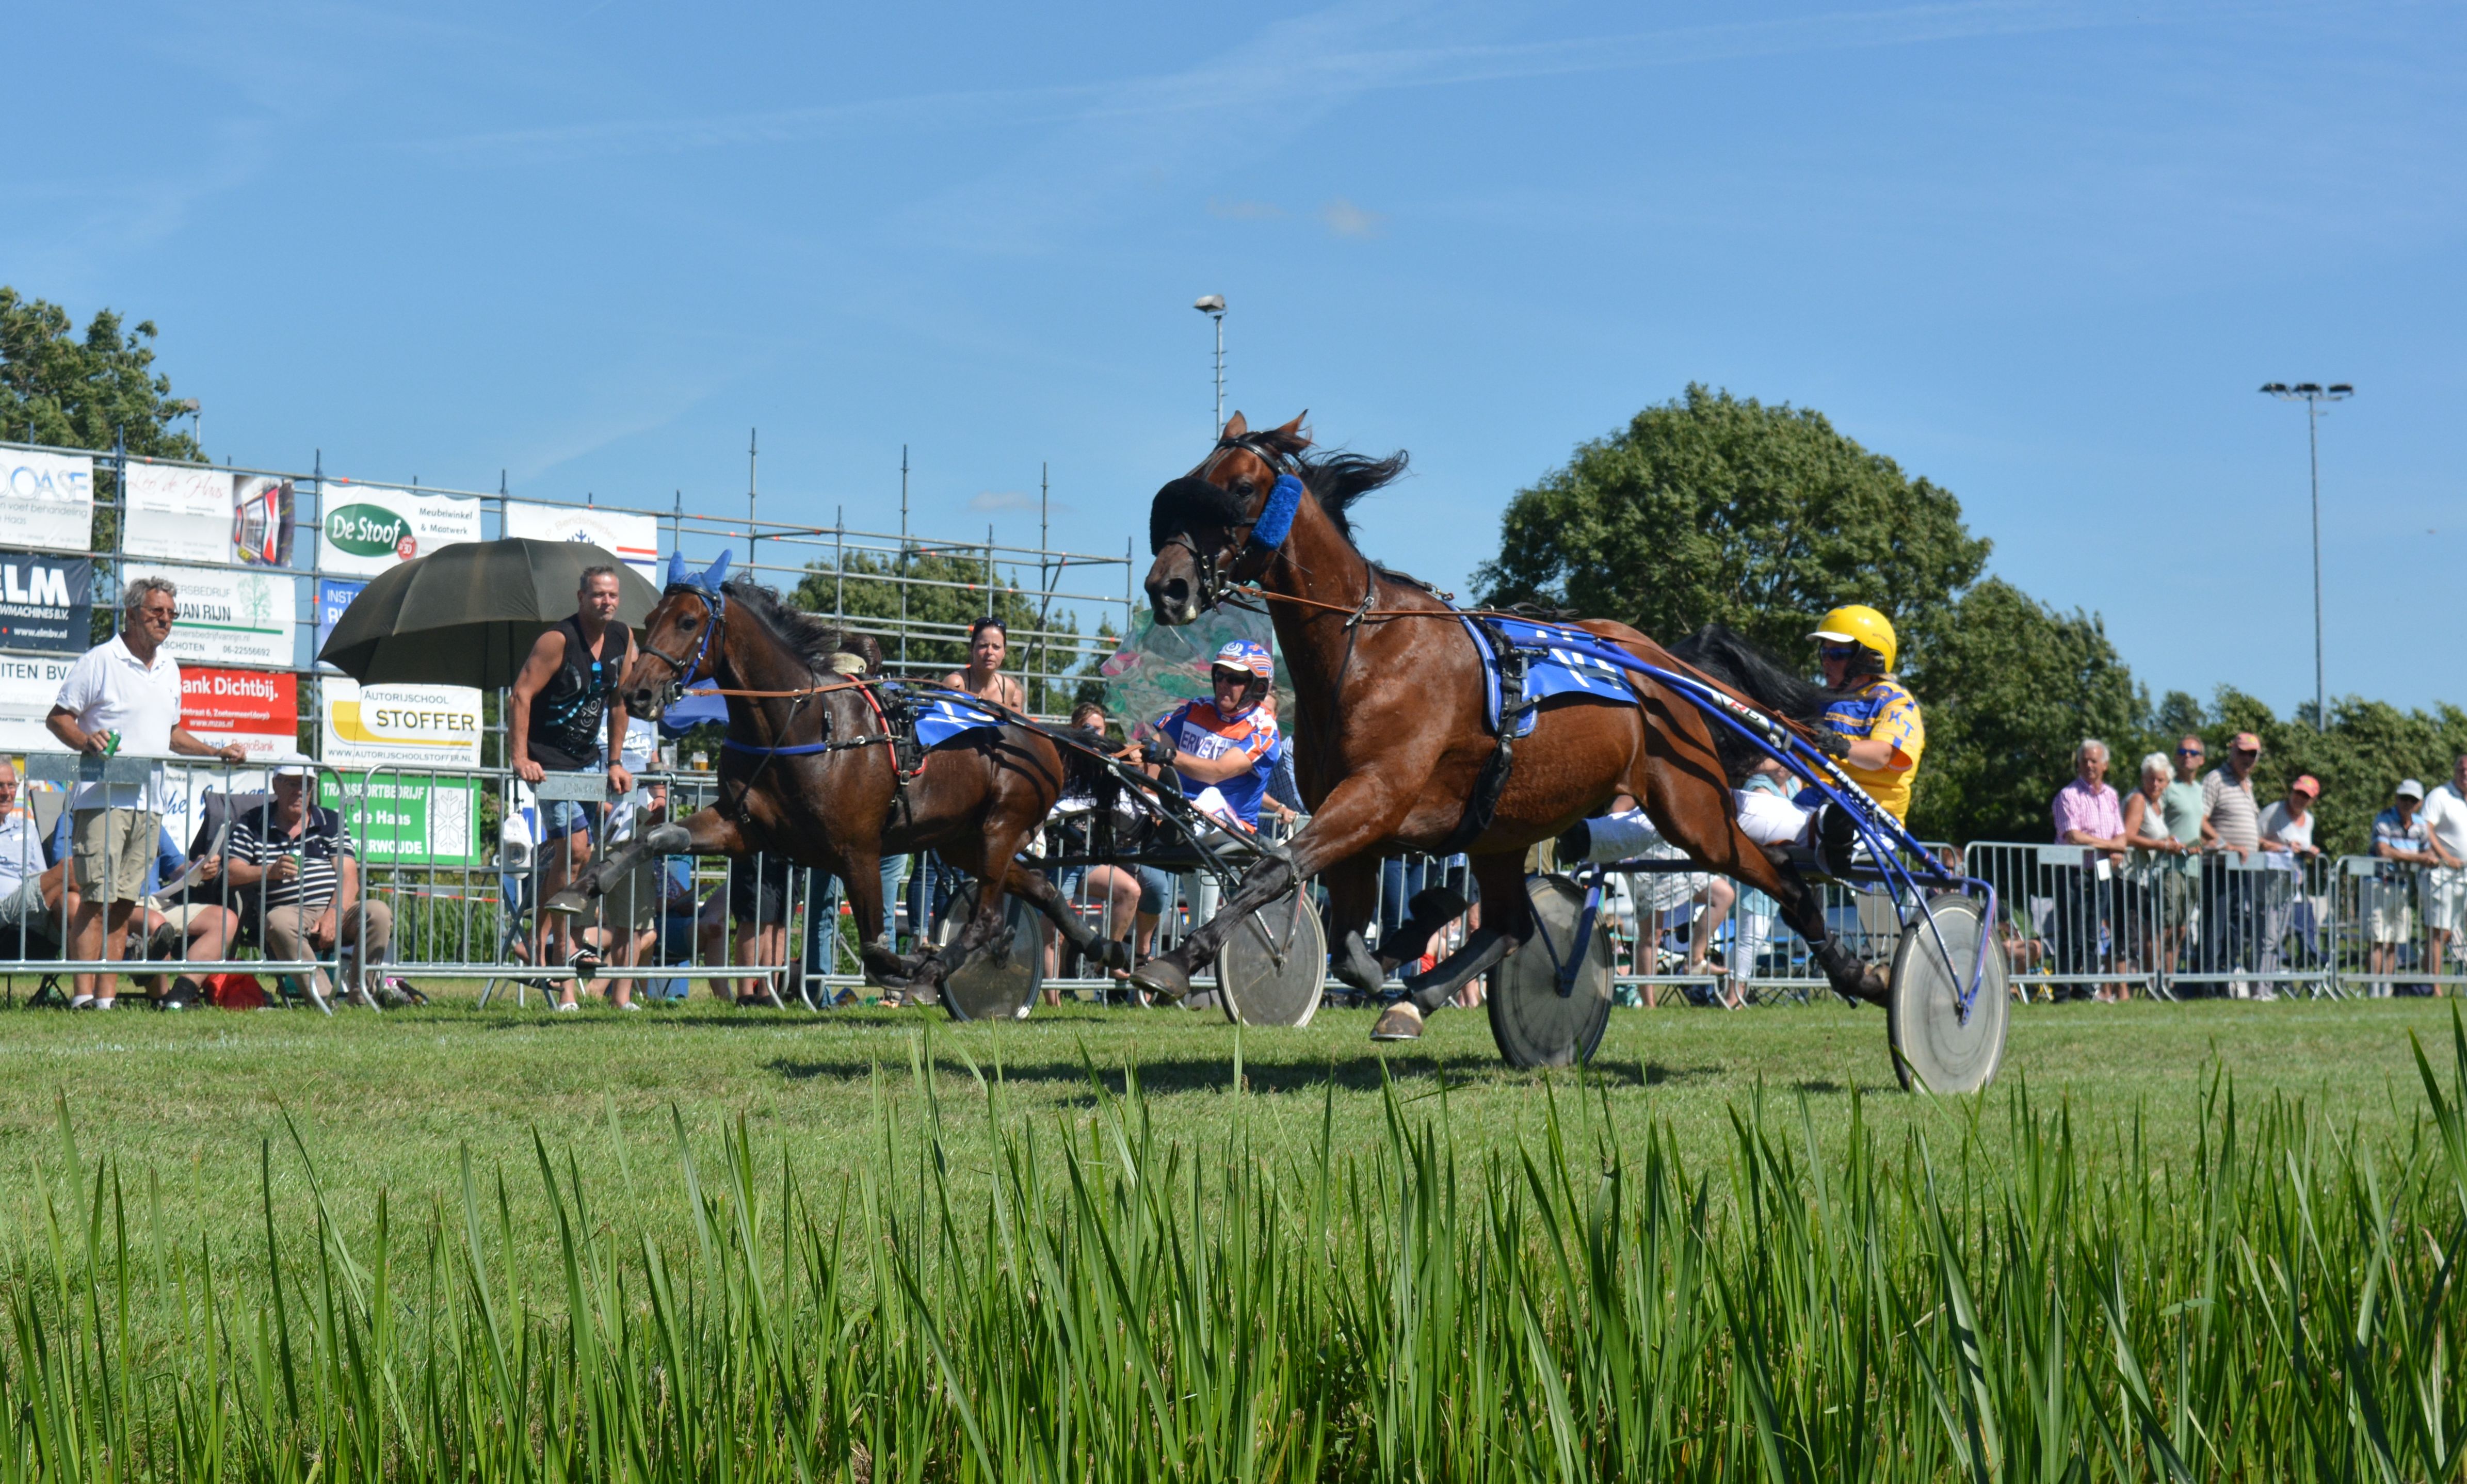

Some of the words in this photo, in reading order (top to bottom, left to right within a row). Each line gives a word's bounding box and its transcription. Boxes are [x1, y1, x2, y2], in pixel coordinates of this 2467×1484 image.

[31, 504, 87, 519] behandeling
[420, 508, 473, 520] Meubelwinkel
[332, 514, 356, 540] De
[357, 517, 402, 550] Stoof
[430, 524, 467, 535] Maatwerk
[176, 584, 231, 598] ERSBEDRIJF
[327, 589, 360, 603] INST
[203, 605, 231, 621] RIJN
[47, 666, 67, 680] BV
[181, 675, 211, 694] ank
[215, 676, 279, 702] Dichtbij.
[376, 709, 475, 731] STOFFER
[352, 809, 373, 824] de
